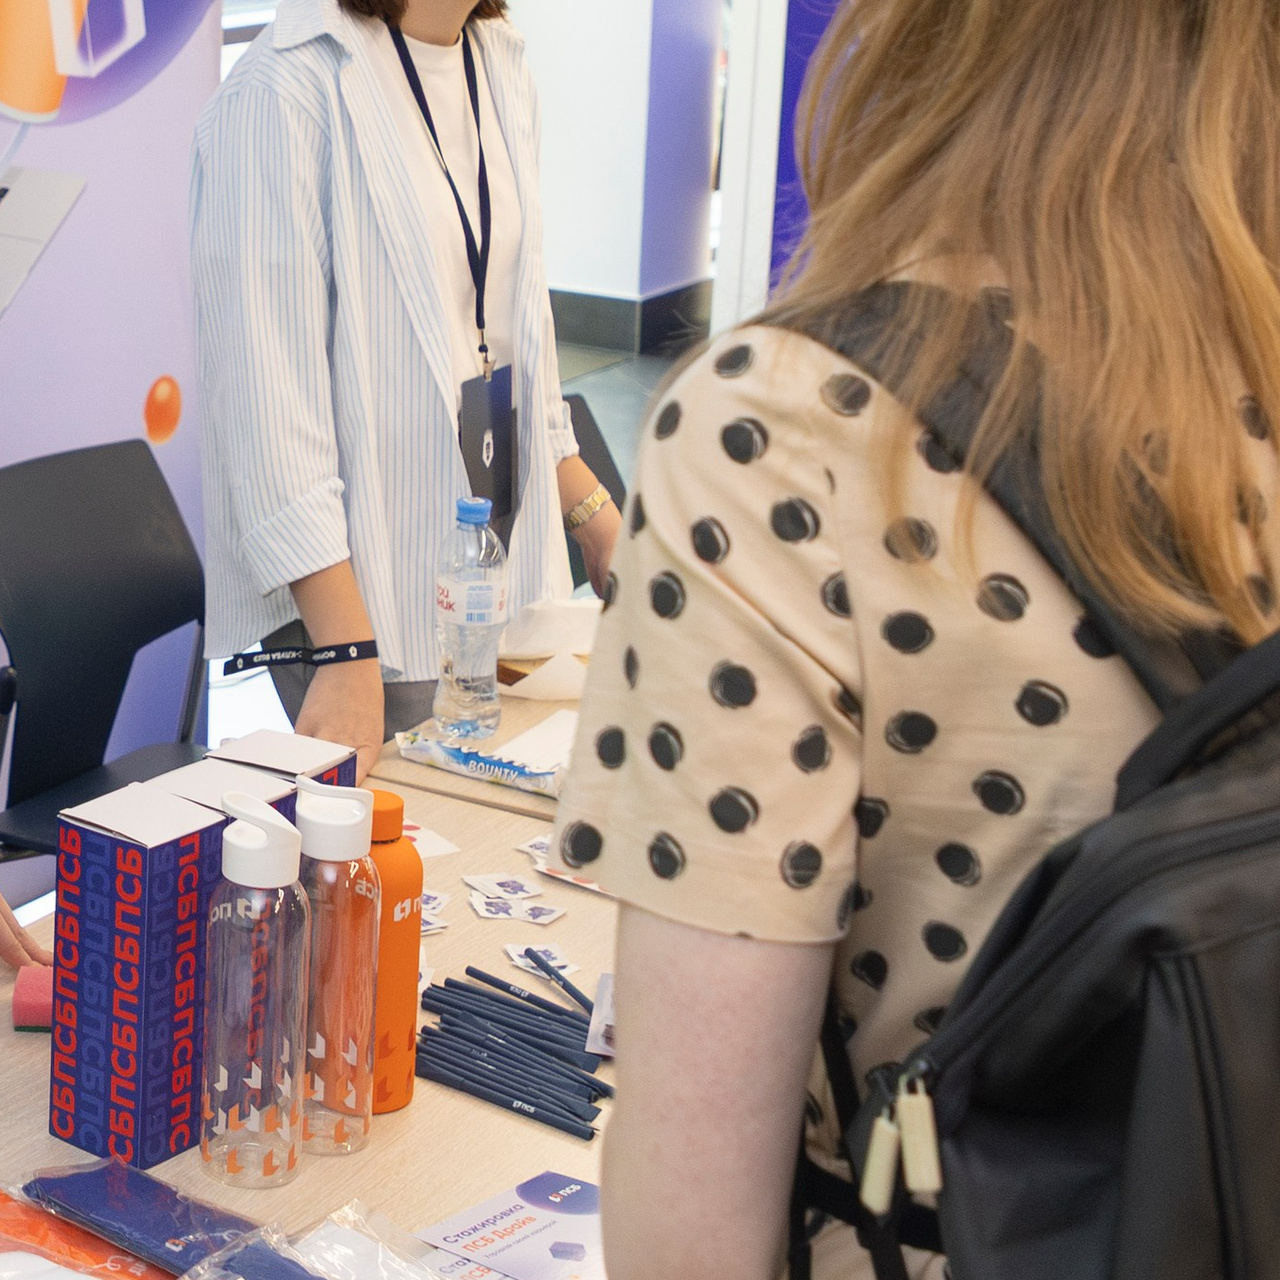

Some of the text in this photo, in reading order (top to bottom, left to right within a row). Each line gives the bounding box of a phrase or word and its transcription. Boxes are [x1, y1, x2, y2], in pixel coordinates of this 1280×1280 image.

[469, 760, 519, 782] BOUNTY
[442, 1203, 525, 1244] Стажировка
[462, 1215, 537, 1253] ПСБ Драйв
